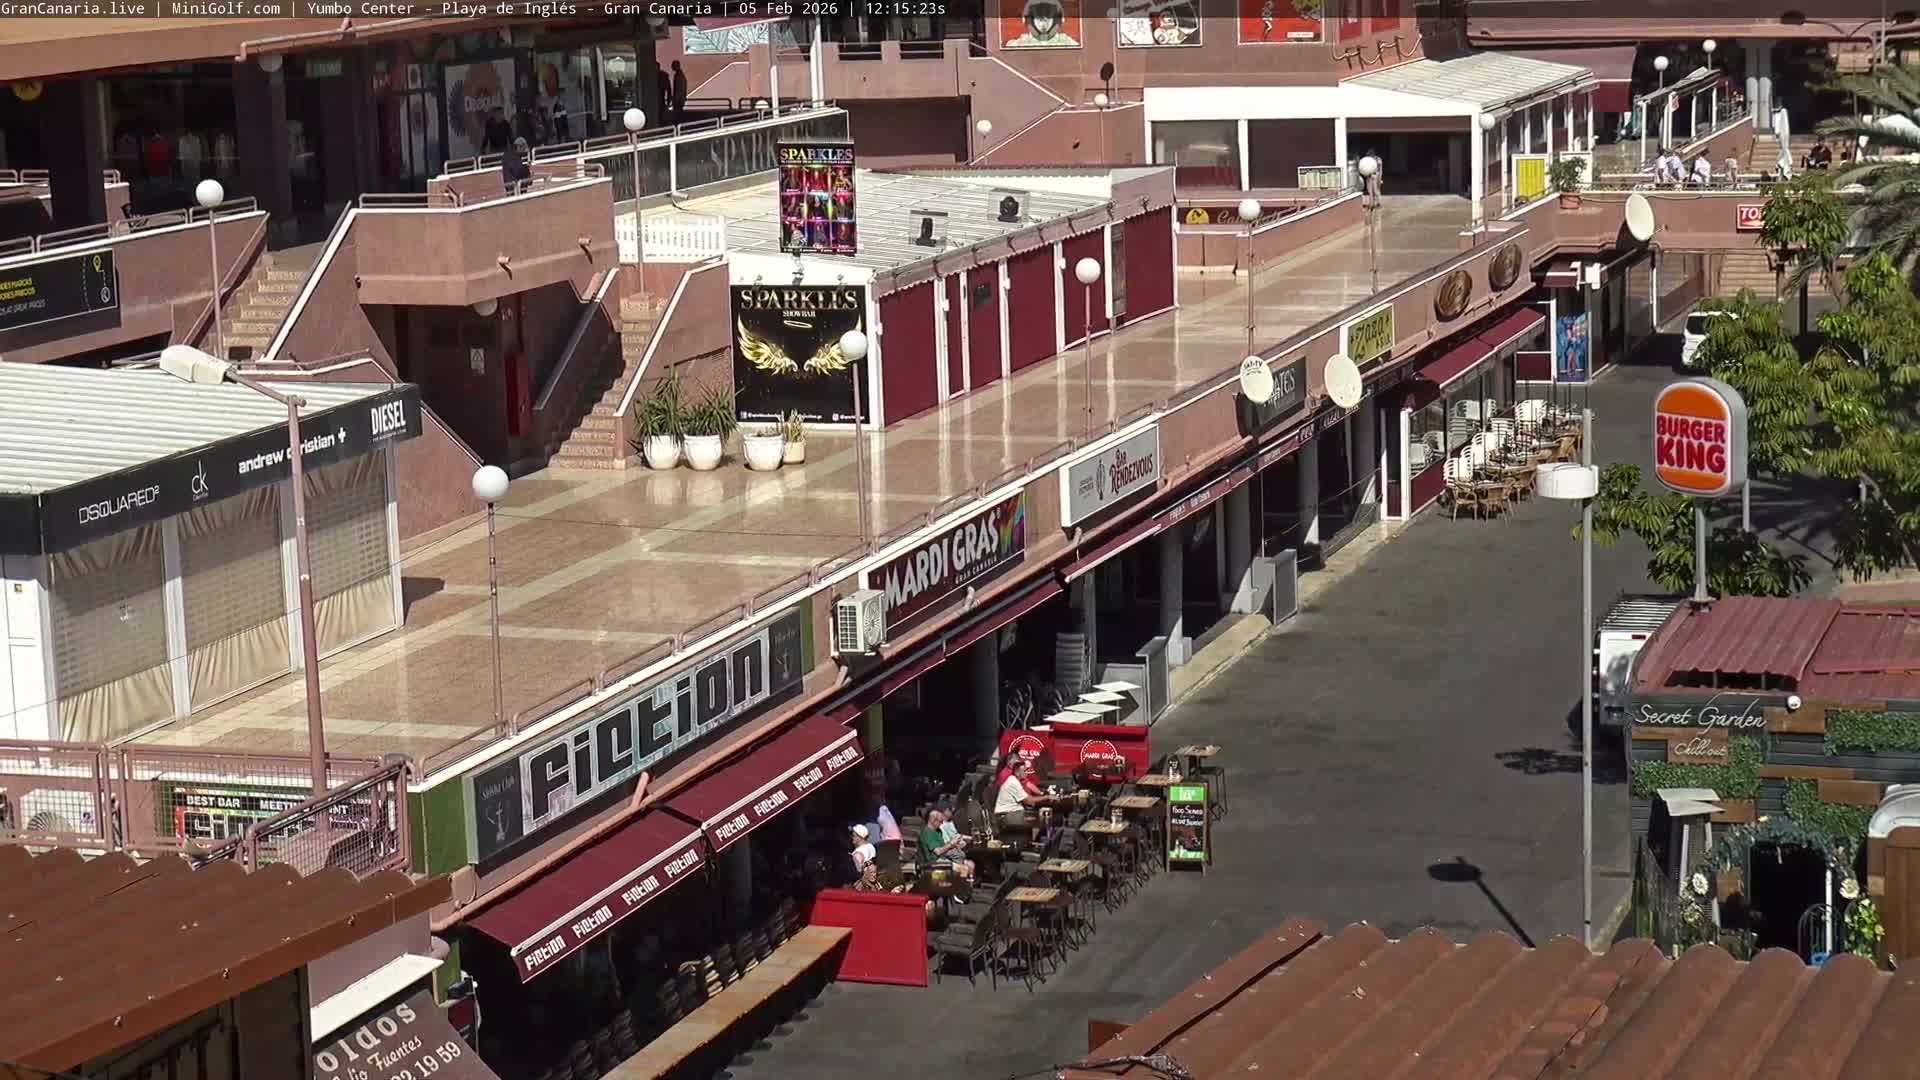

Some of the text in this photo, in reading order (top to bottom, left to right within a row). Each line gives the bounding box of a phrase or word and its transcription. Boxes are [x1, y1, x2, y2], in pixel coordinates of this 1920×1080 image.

[780, 148, 855, 163] SPARKLES
[740, 289, 859, 311] SPARKLES
[371, 400, 406, 435] DIESEL
[1656, 414, 1726, 444] BURGER
[238, 434, 335, 475] andrew cristian
[1656, 437, 1727, 475] KING
[884, 538, 949, 612] MARDI
[1635, 697, 1768, 738] Secret Garden
[186, 795, 215, 806] BEST
[217, 796, 240, 808] BAR
[316, 1002, 417, 1072] oldos
[367, 1035, 422, 1072] Fuentes
[415, 1055, 439, 1079] 19
[436, 1040, 462, 1065] 59
